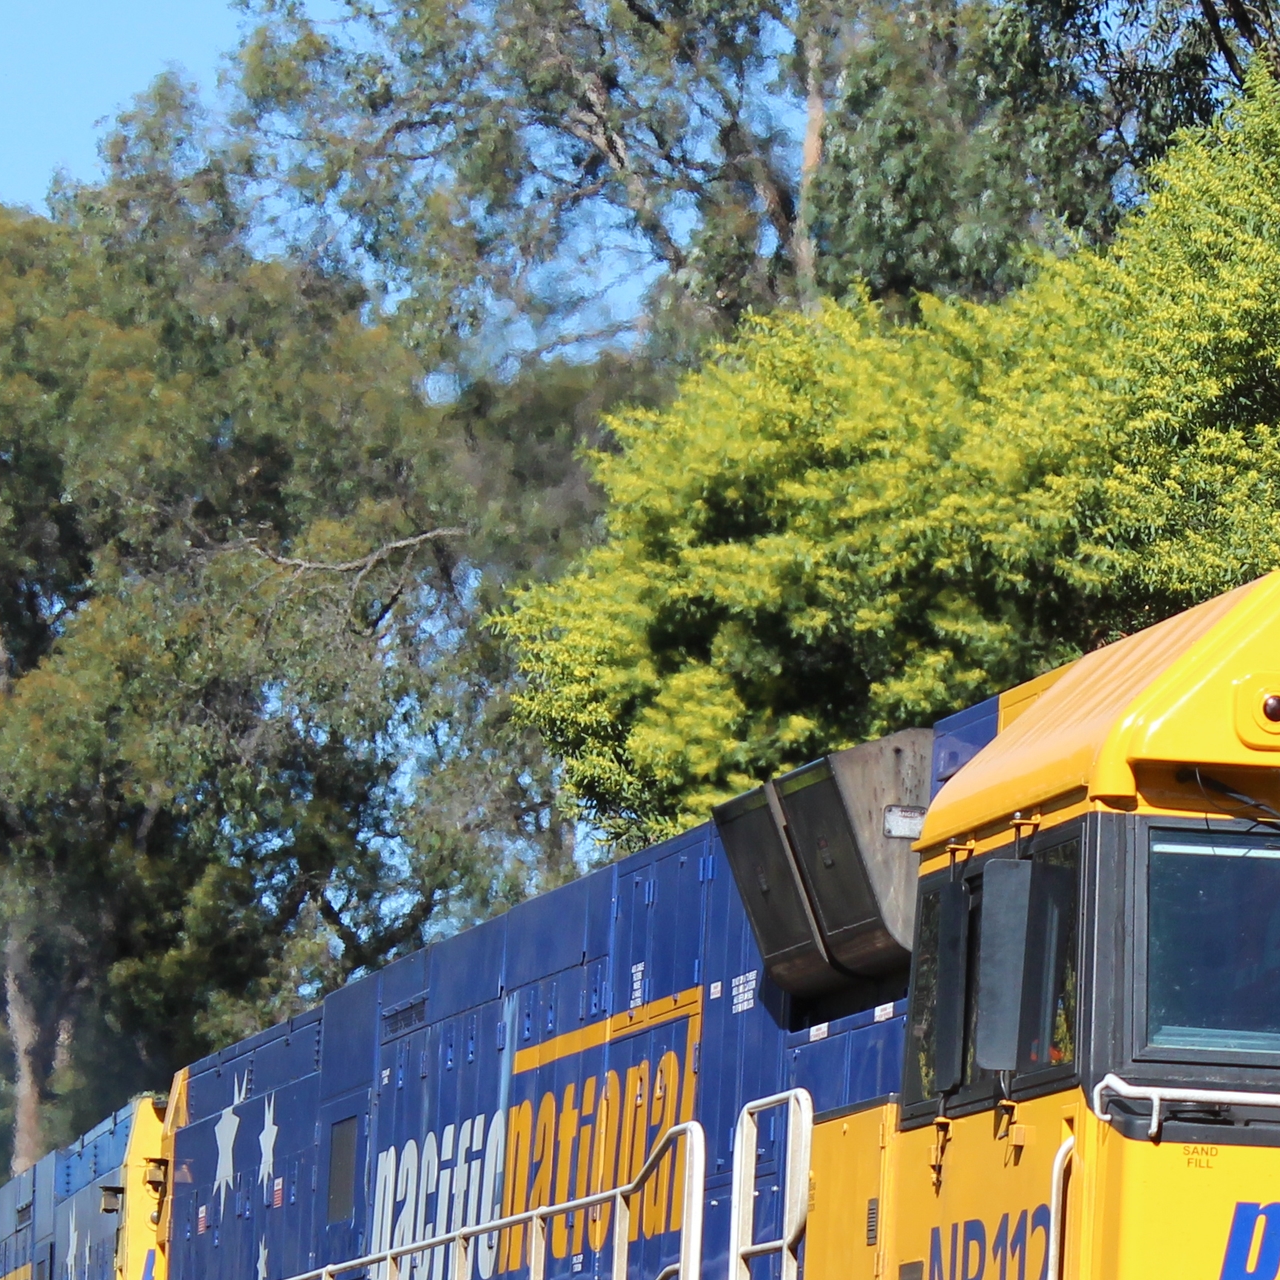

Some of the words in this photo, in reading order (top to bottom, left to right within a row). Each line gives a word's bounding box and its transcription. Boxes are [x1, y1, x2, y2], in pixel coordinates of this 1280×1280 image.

[497, 985, 703, 1276] national
[1183, 1145, 1219, 1157] SAND
[1187, 1157, 1214, 1169] FILL
